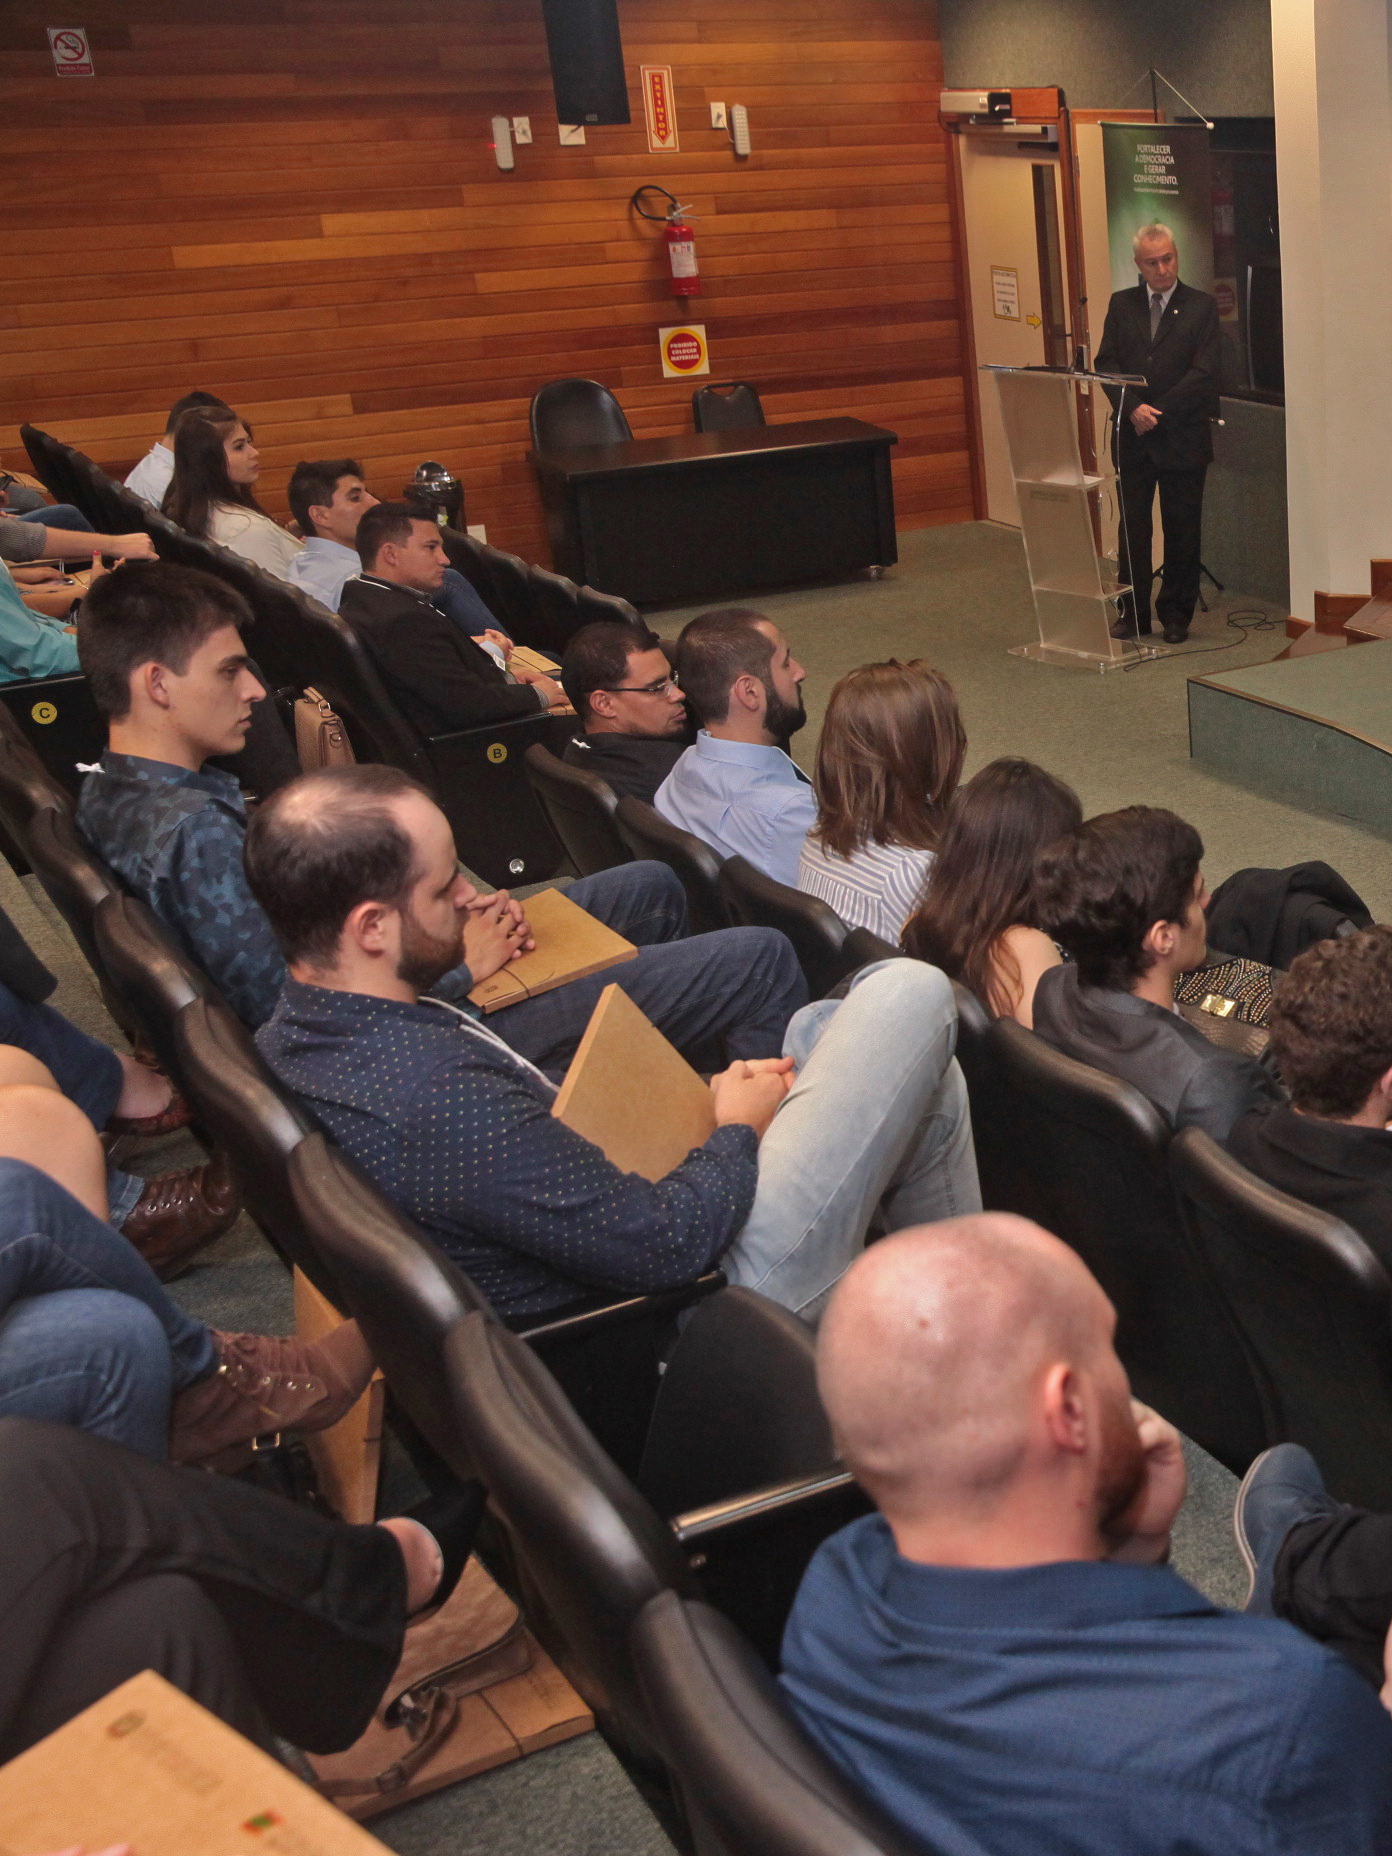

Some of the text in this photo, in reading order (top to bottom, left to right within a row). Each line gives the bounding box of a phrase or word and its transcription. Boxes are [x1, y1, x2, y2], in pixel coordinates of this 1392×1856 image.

[654, 76, 666, 137] EXTINTOR
[1137, 144, 1171, 154] FORTALECER
[1139, 155, 1175, 164] DEMOCRACIA
[1148, 165, 1166, 174] GERAR
[670, 341, 698, 349] PROIBIDO
[39, 707, 50, 719] C
[493, 748, 503, 759] B
